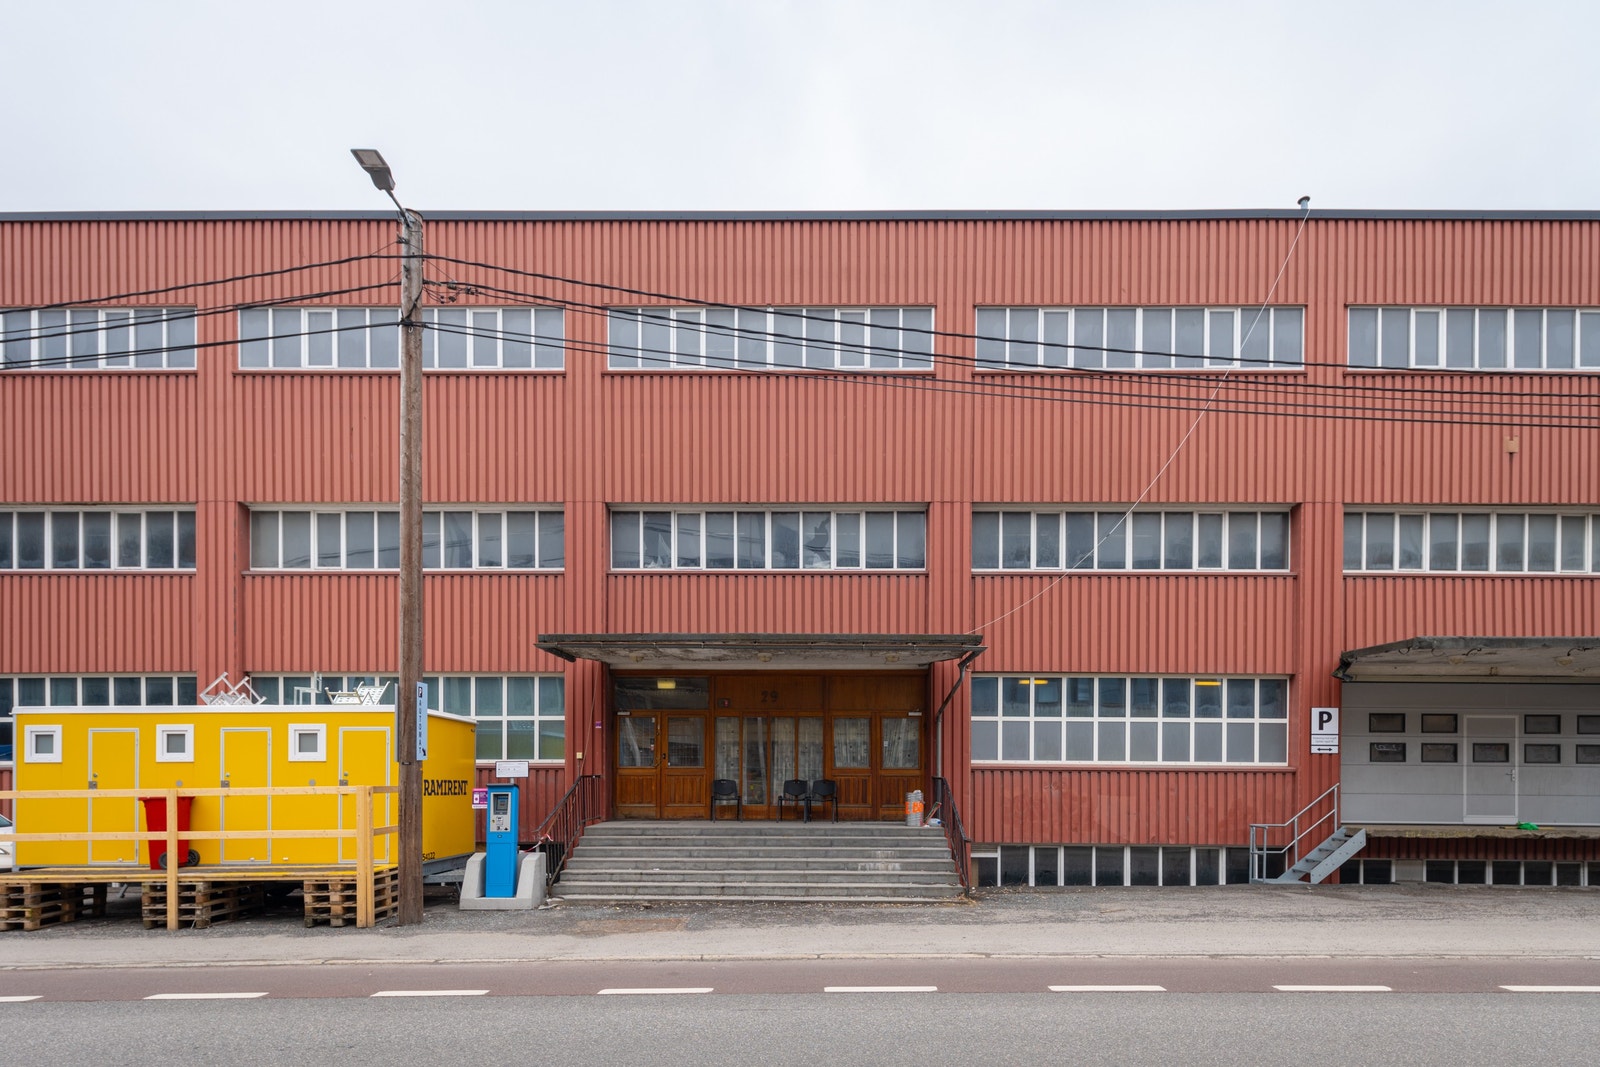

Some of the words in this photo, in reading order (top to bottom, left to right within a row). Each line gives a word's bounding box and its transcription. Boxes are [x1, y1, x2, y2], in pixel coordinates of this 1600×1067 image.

[761, 690, 777, 702] 29
[1318, 711, 1332, 730] P
[423, 780, 468, 796] RAMIRENT
